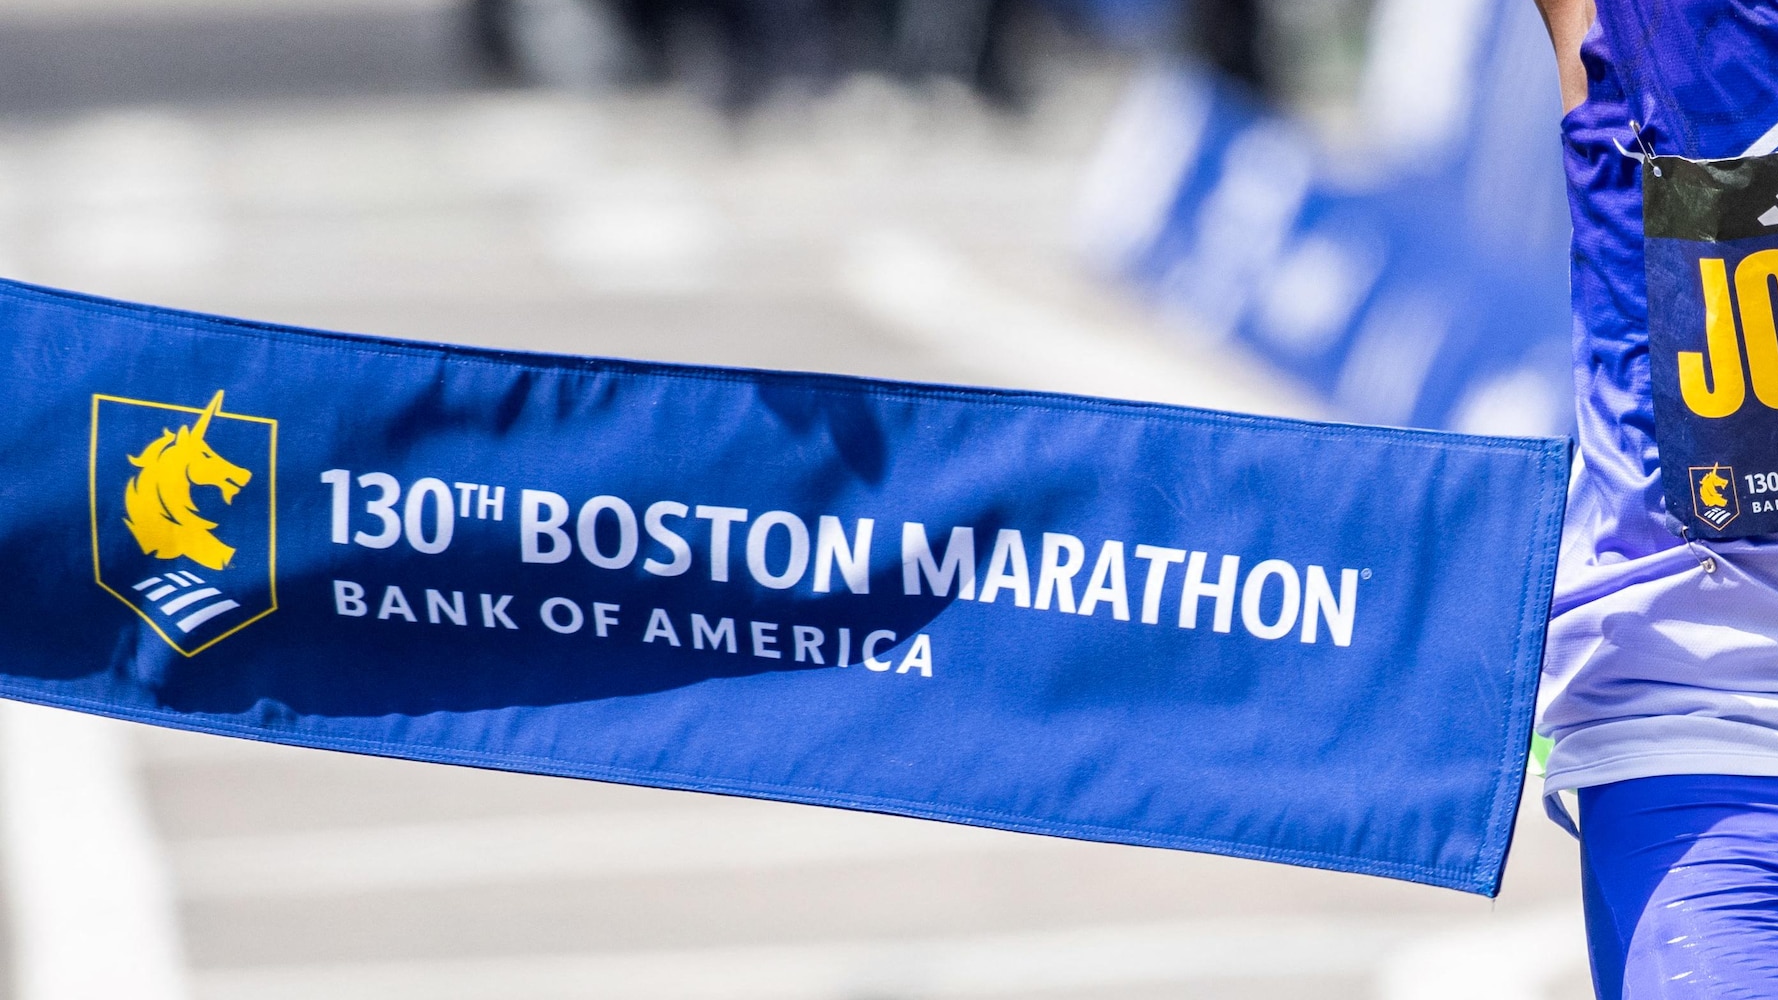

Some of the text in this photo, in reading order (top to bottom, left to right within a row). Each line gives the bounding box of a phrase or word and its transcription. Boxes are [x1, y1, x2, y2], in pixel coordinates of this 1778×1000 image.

[320, 469, 505, 555] 130TH
[521, 490, 874, 594] BOSTON
[335, 580, 933, 677] BANK OF AMERICA
